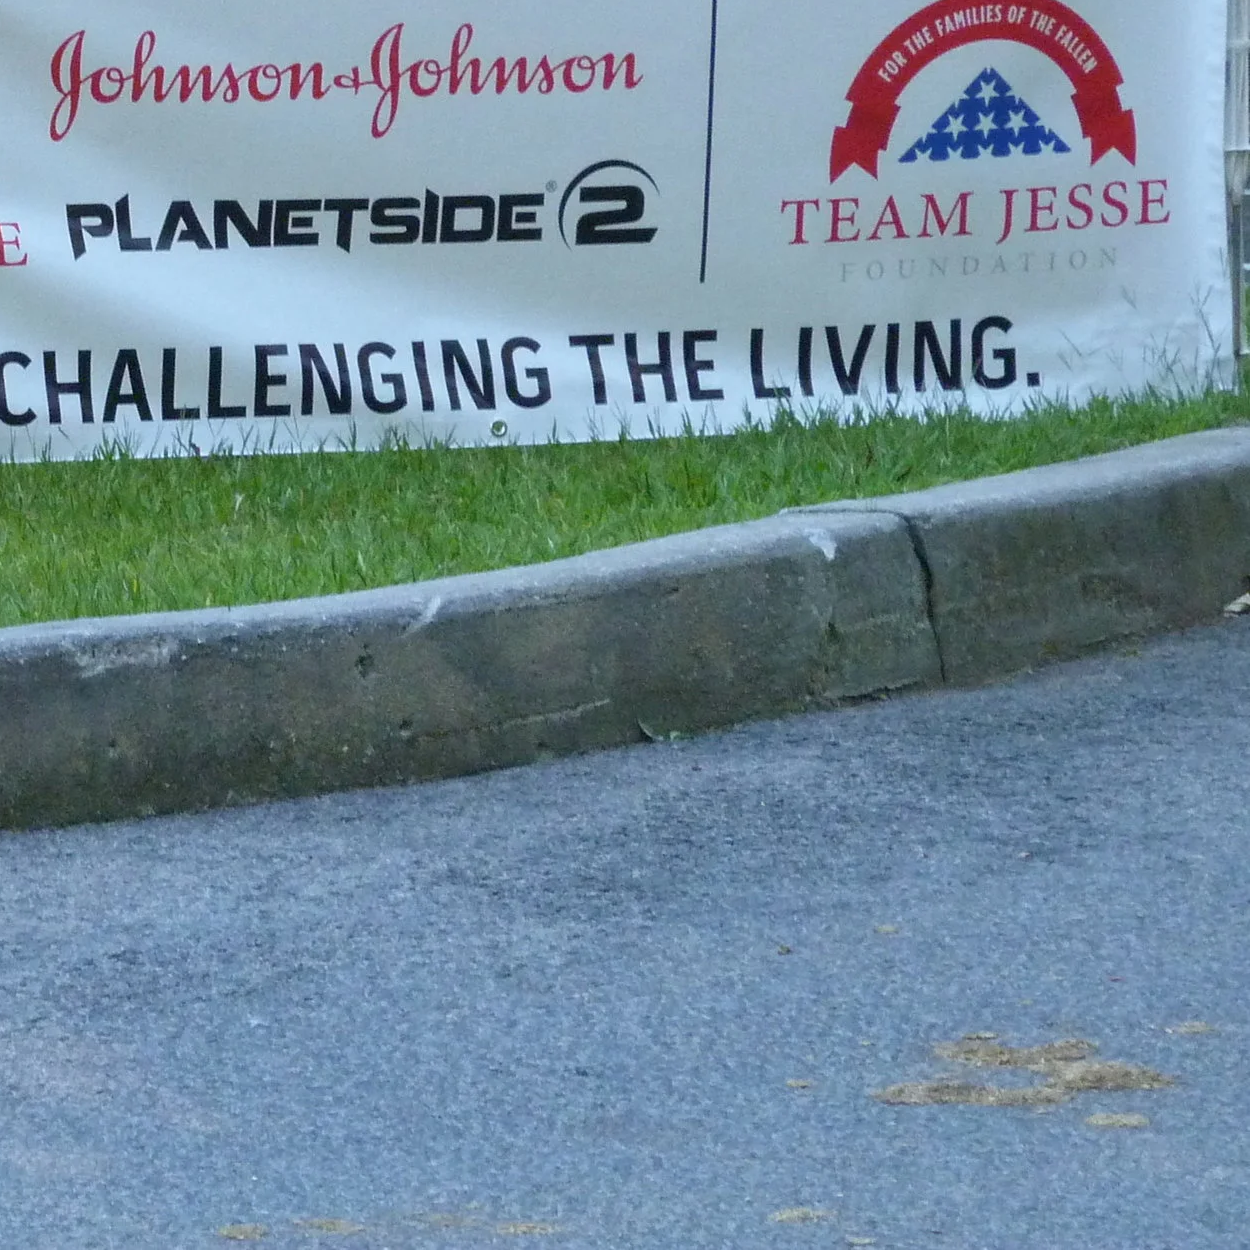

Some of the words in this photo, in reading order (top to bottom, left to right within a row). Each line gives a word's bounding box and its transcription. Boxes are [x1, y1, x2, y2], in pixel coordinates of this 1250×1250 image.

[878, 51, 907, 83] FOR
[903, 25, 934, 55] THE
[934, 4, 1002, 36] FAMILIES
[1008, 5, 1026, 23] OF
[1030, 10, 1057, 36] THE
[1054, 26, 1098, 74] FALLEN
[575, 185, 658, 246] 2
[781, 192, 973, 245] TEAM
[996, 179, 1171, 244] JESSE
[840, 247, 1118, 283] FOUNDATION
[569, 328, 724, 405] THE
[750, 314, 1041, 400] LIVING.
